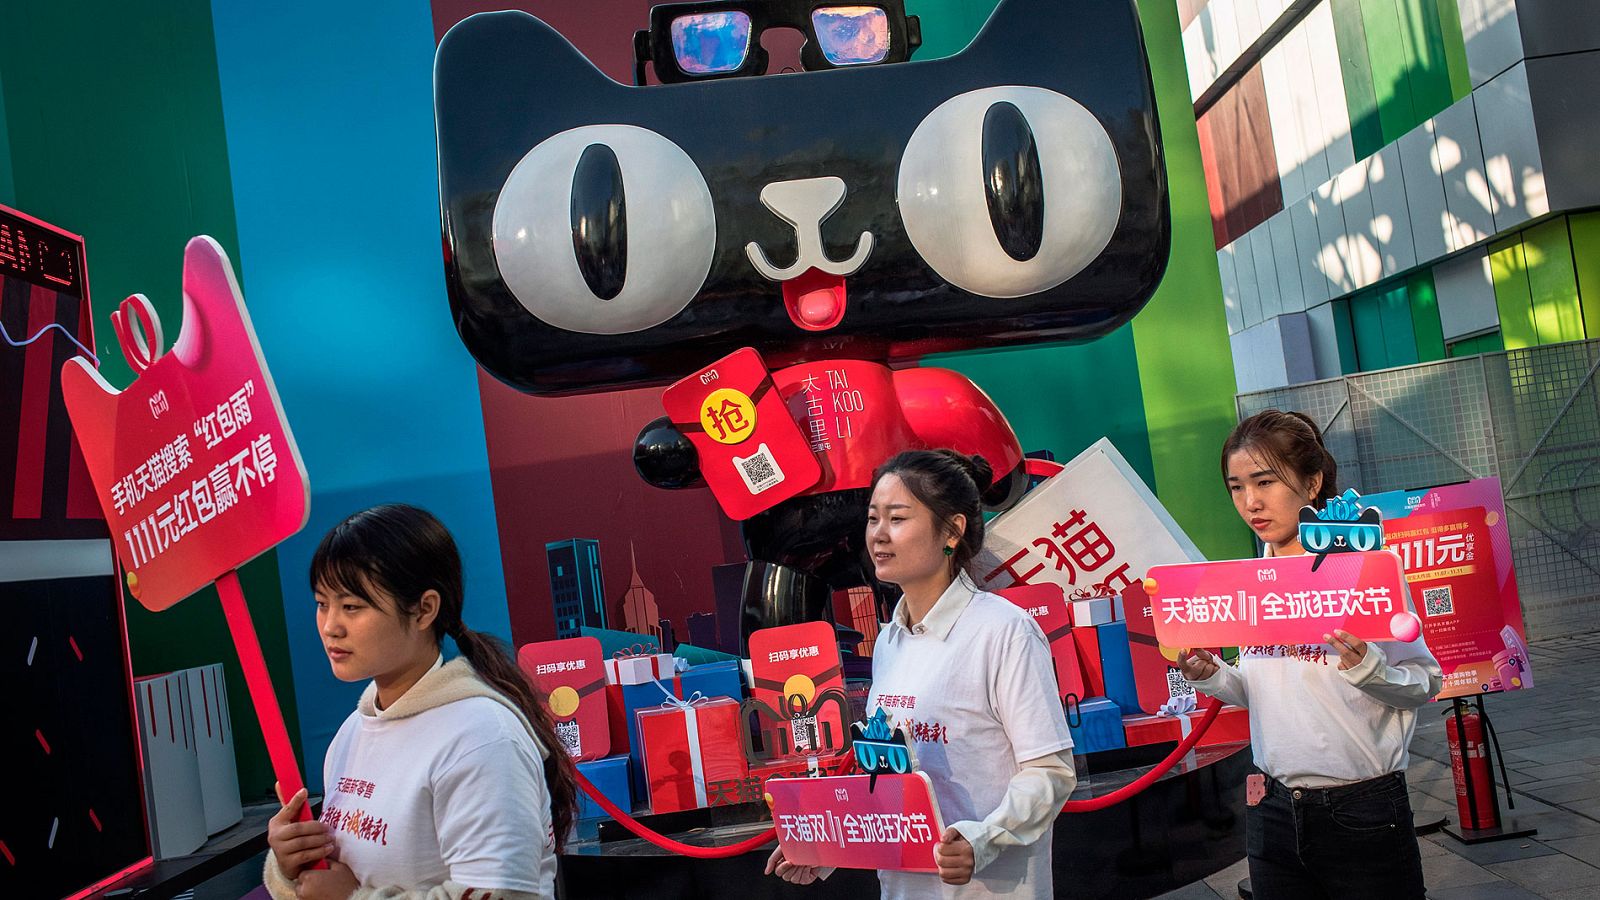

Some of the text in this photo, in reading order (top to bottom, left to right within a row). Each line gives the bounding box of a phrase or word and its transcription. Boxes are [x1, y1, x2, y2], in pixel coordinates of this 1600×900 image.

[826, 369, 849, 389] TAI
[801, 374, 830, 443] 太古里
[832, 390, 864, 413] KOO
[706, 398, 750, 441] 抢
[837, 416, 852, 439] LI
[124, 433, 278, 569] 1111元红包赢不停
[1024, 605, 1049, 617] 优惠
[768, 646, 819, 663] 扫码享优惠
[536, 659, 586, 675] 扫码享优惠
[779, 810, 933, 848] 天猫双11全球狂欢节
